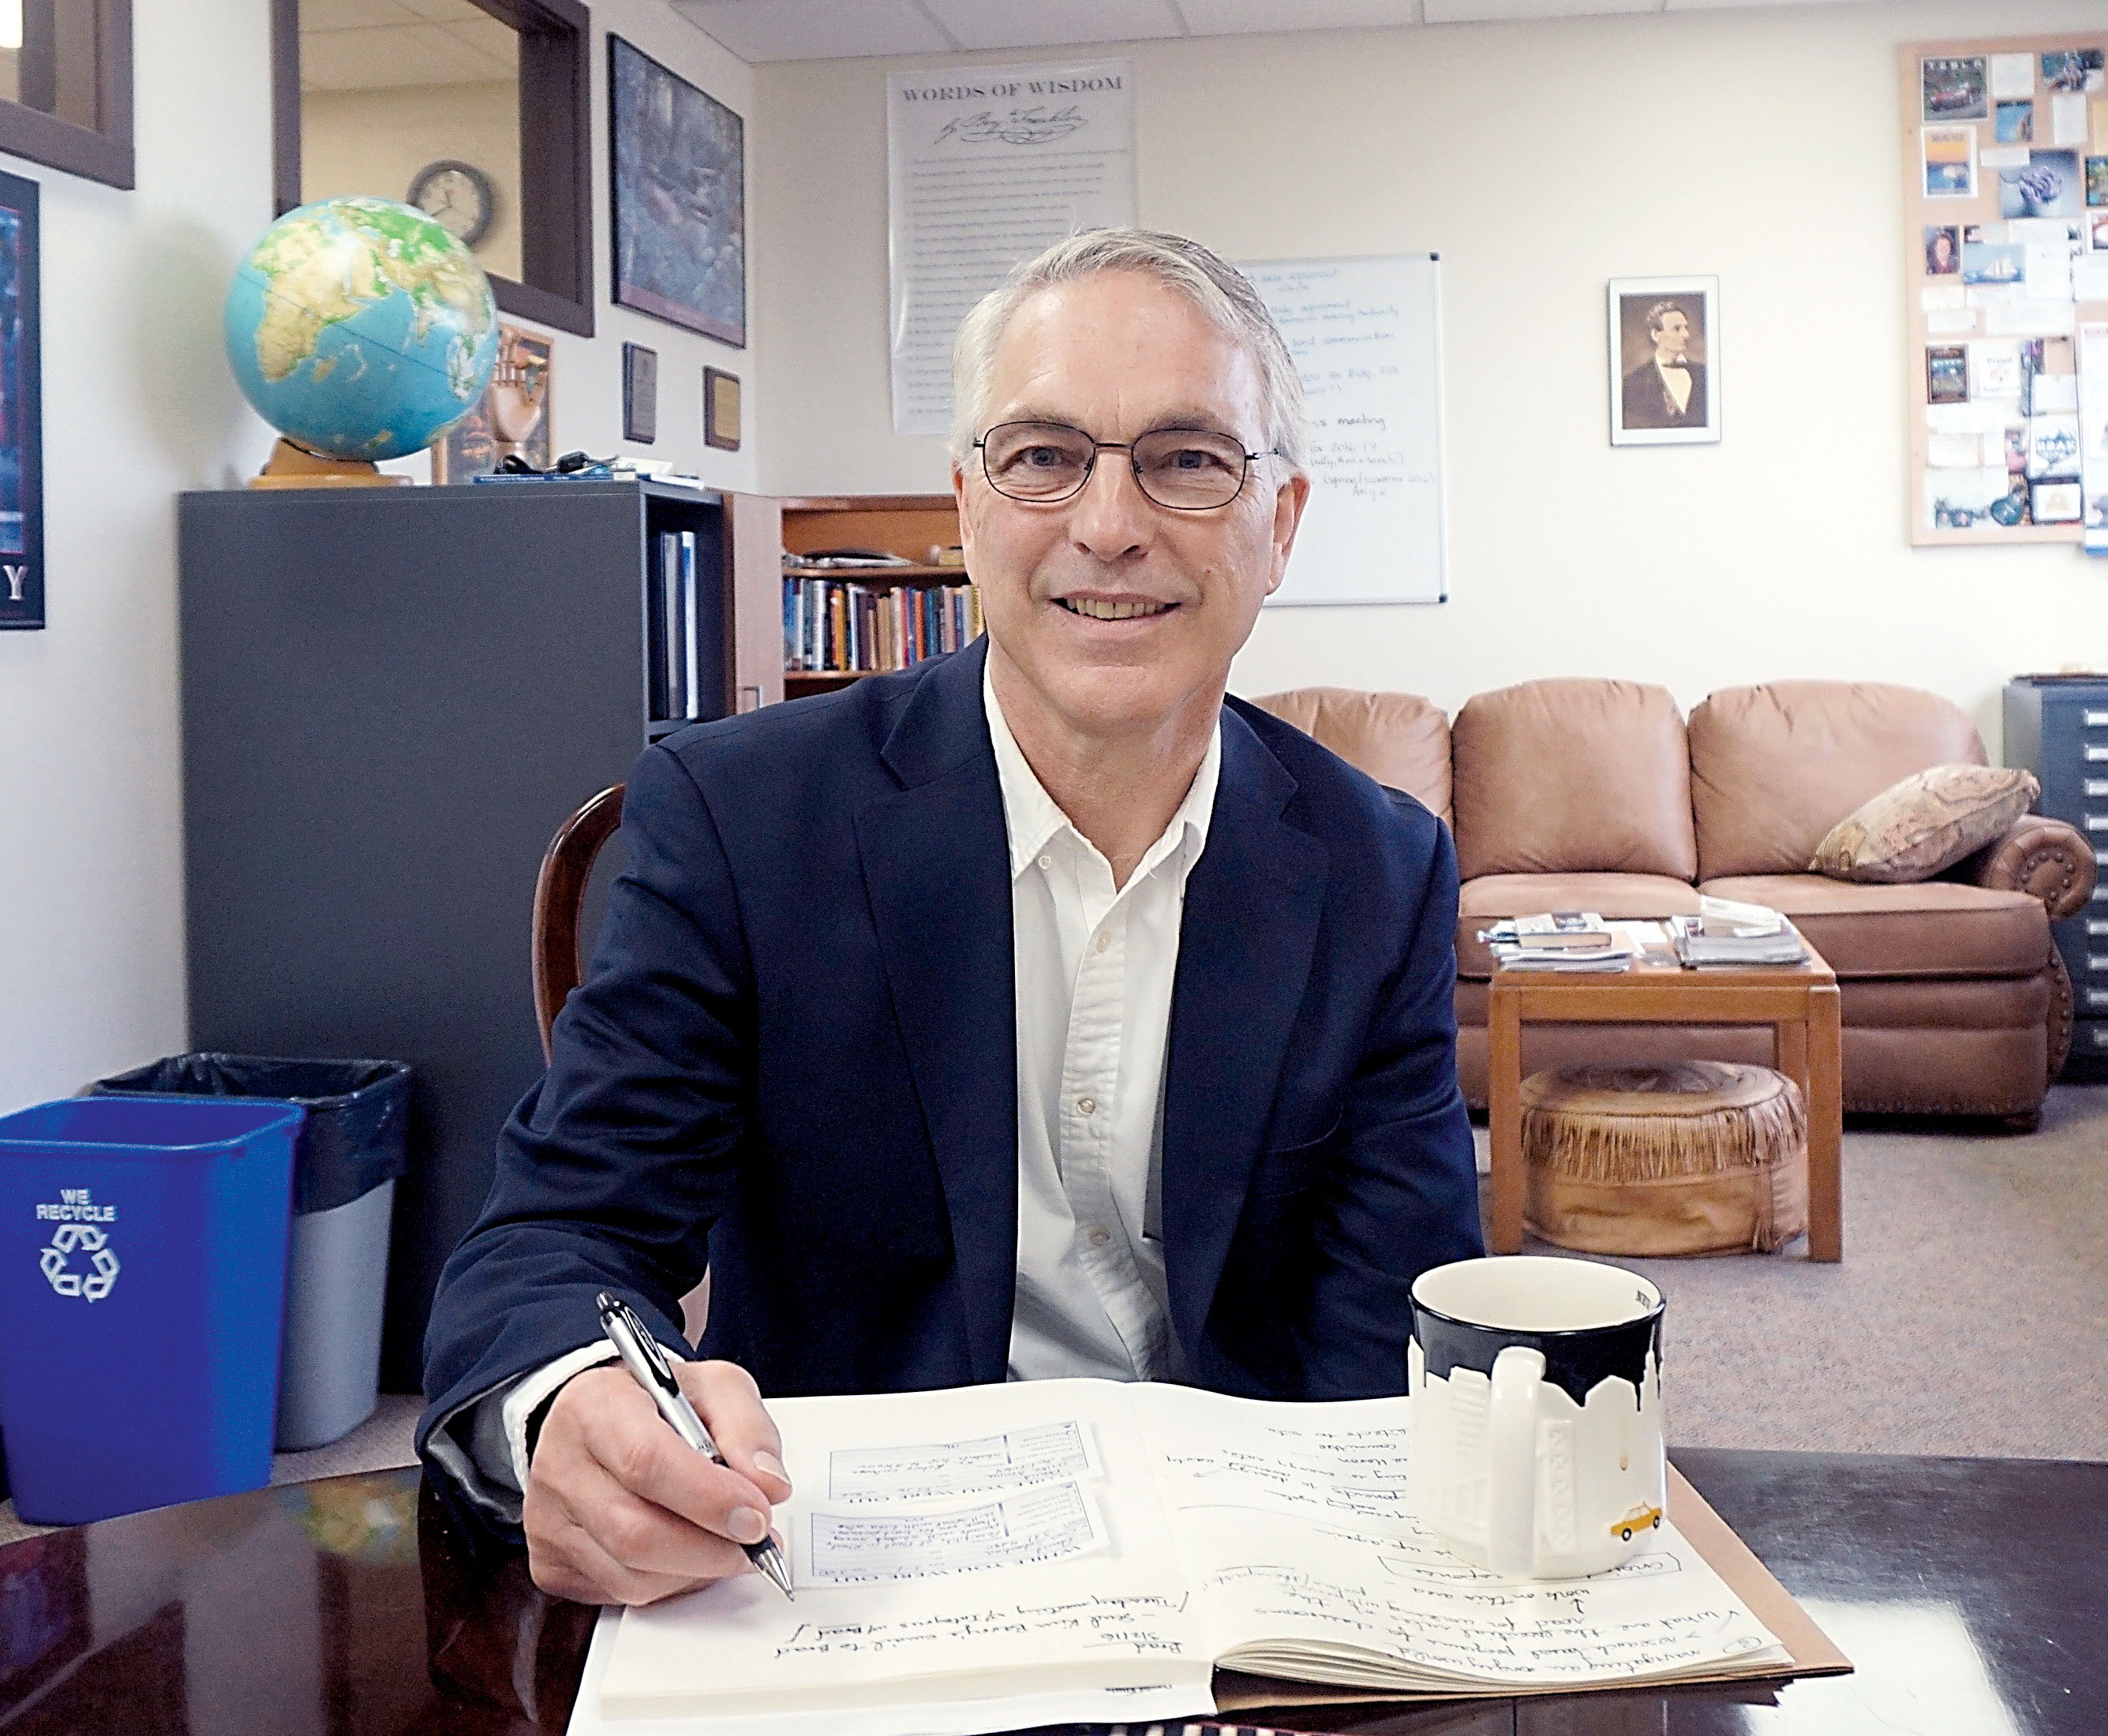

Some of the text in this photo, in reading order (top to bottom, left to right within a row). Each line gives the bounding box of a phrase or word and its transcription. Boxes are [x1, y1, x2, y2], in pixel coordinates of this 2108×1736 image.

[902, 77, 1124, 102] WORDS OF WISDOM
[1339, 413, 1387, 431] meeting
[60, 1188, 90, 1205] WE
[36, 1203, 118, 1222] RECYCLE
[1410, 1586, 1454, 1600] area
[1464, 1595, 1513, 1607] this
[1132, 1641, 1183, 1656] Brad
[1386, 1643, 1702, 1674] navigating an angry world
